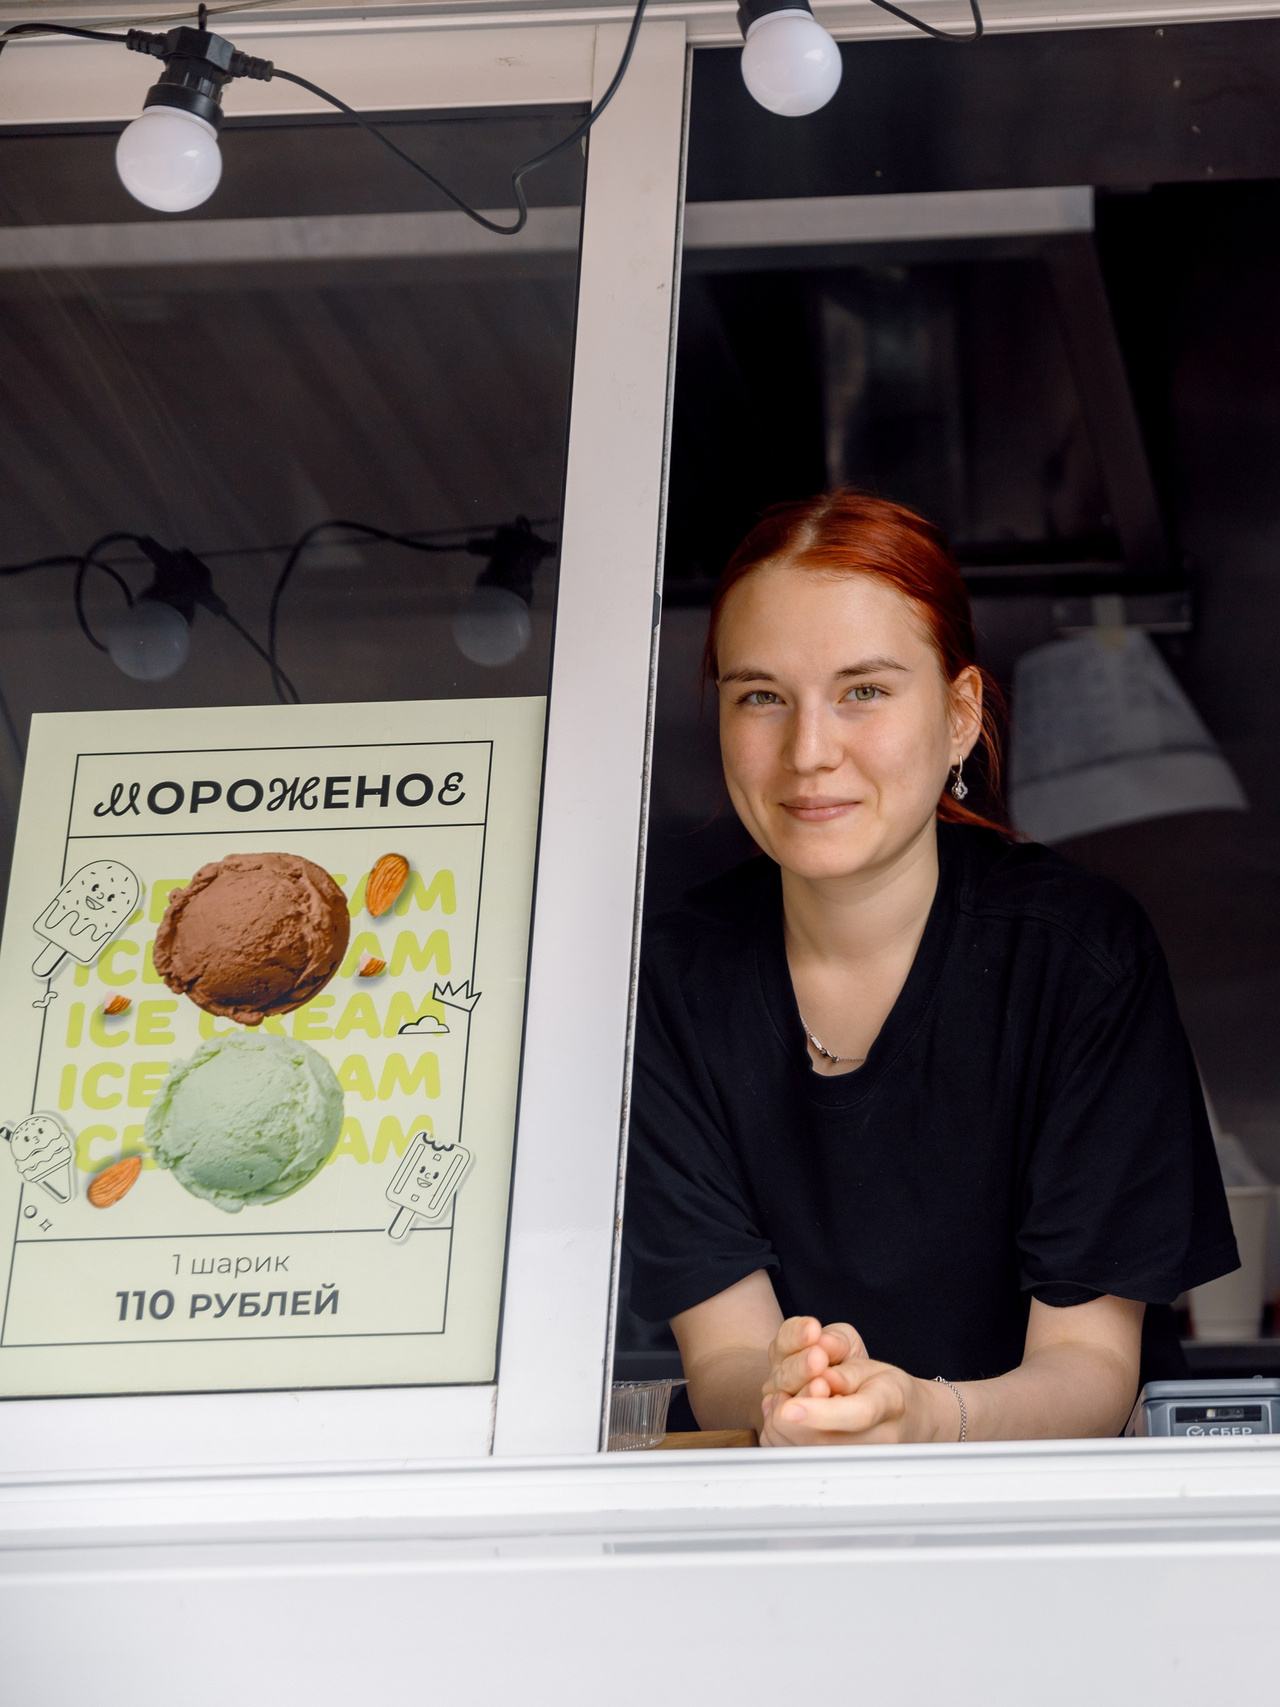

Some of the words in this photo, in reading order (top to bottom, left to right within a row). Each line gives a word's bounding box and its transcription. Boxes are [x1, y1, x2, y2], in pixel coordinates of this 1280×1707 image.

[93, 772, 466, 817] МОРОЖЕНОЕ
[66, 1000, 179, 1049] ICE
[172, 1254, 181, 1275] 1
[191, 1255, 290, 1279] шарик
[115, 1289, 175, 1321] 110
[189, 1283, 340, 1319] РУБЛЕЙ
